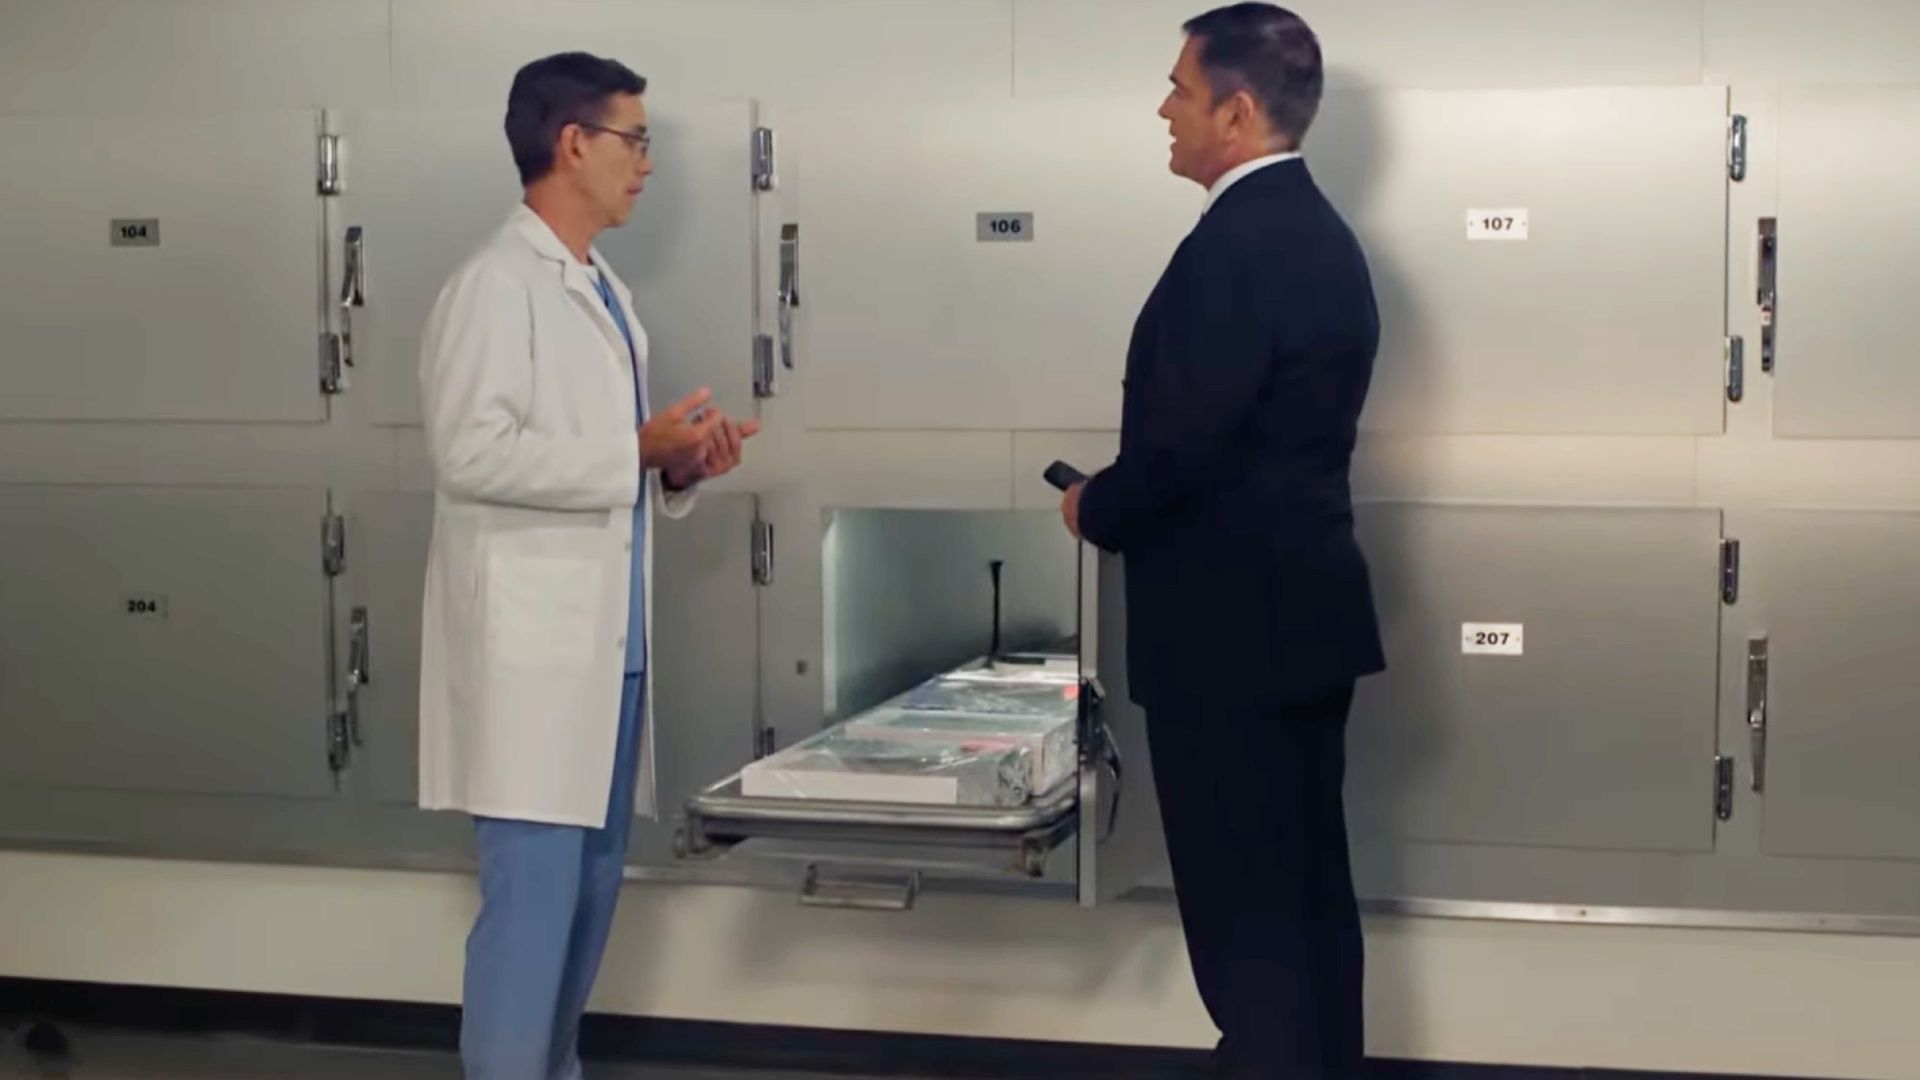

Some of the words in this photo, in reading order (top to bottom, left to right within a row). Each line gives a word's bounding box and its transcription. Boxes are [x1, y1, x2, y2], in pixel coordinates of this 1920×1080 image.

[990, 219, 1021, 233] 106
[1483, 217, 1514, 231] 107
[120, 225, 147, 239] 104
[127, 599, 156, 613] 204
[1475, 631, 1510, 645] 207
